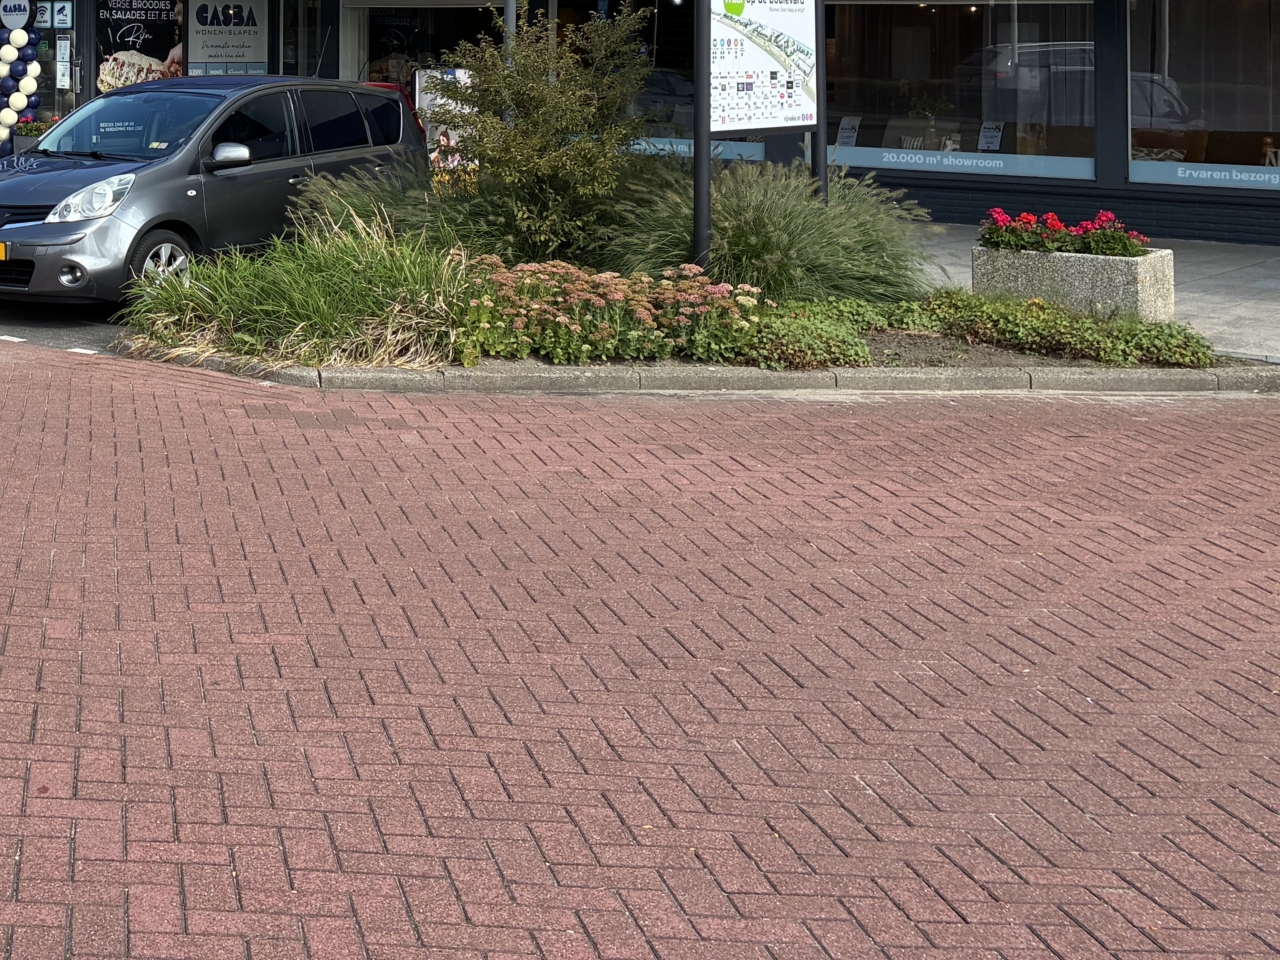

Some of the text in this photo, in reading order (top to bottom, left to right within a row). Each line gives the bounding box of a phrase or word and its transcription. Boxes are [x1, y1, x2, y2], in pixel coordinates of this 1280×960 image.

[2, 3, 28, 14] CASBA
[108, 0, 171, 10] VERSE BROODJES
[99, 9, 110, 19] EN
[111, 10, 146, 20] SALADES
[147, 11, 160, 20] EET
[160, 11, 168, 20] JE
[195, 3, 258, 28] CASBA
[882, 152, 924, 164] 20.000
[942, 155, 1004, 168] showroom
[1177, 167, 1230, 180] Ervaren
